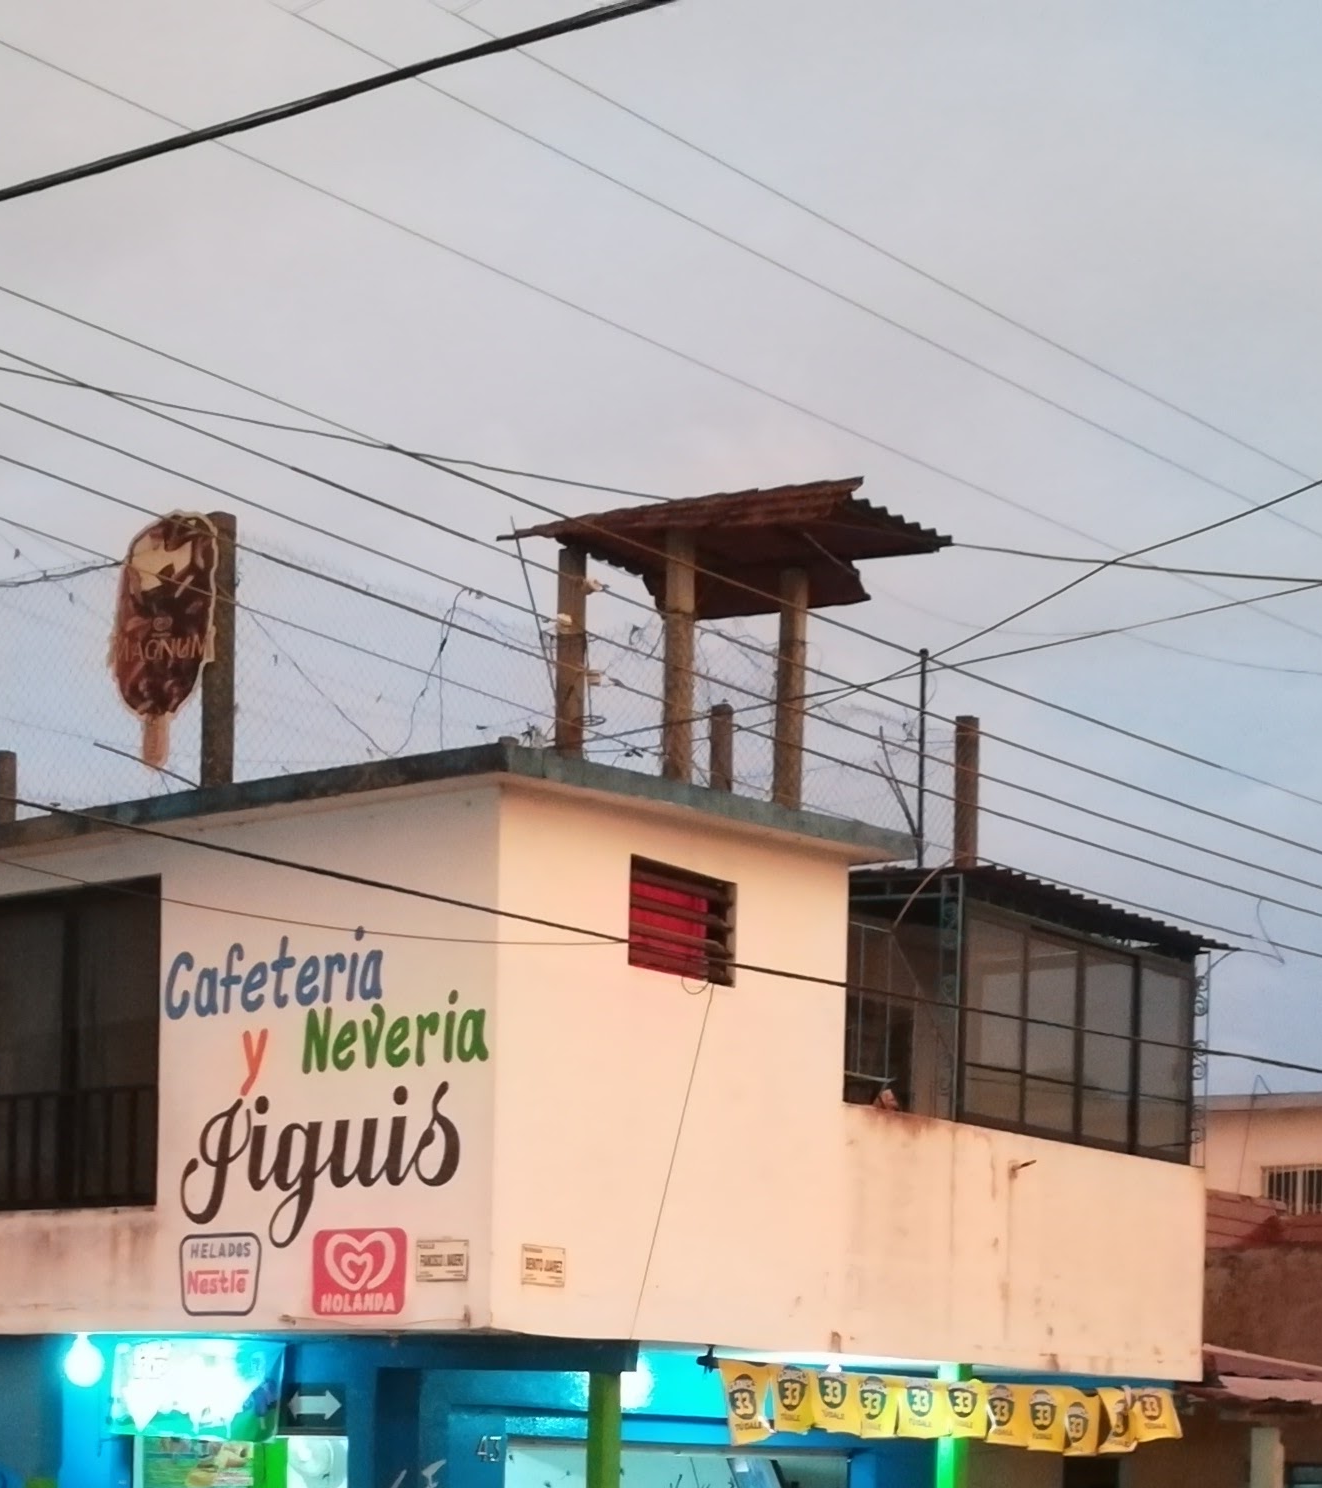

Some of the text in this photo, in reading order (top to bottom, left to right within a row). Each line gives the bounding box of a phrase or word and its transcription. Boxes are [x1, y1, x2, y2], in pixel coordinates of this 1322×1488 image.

[240, 1028, 268, 1096] y
[181, 1081, 460, 1248] Jiguis
[190, 1243, 251, 1259] HELADOS
[321, 1293, 395, 1312] HOLANDA
[734, 1390, 754, 1415] 33
[784, 1382, 801, 1406] 33
[826, 1380, 842, 1405] 33
[864, 1392, 882, 1417] 33
[913, 1387, 929, 1412] 33
[953, 1391, 970, 1413] 33
[1035, 1403, 1051, 1426] 33
